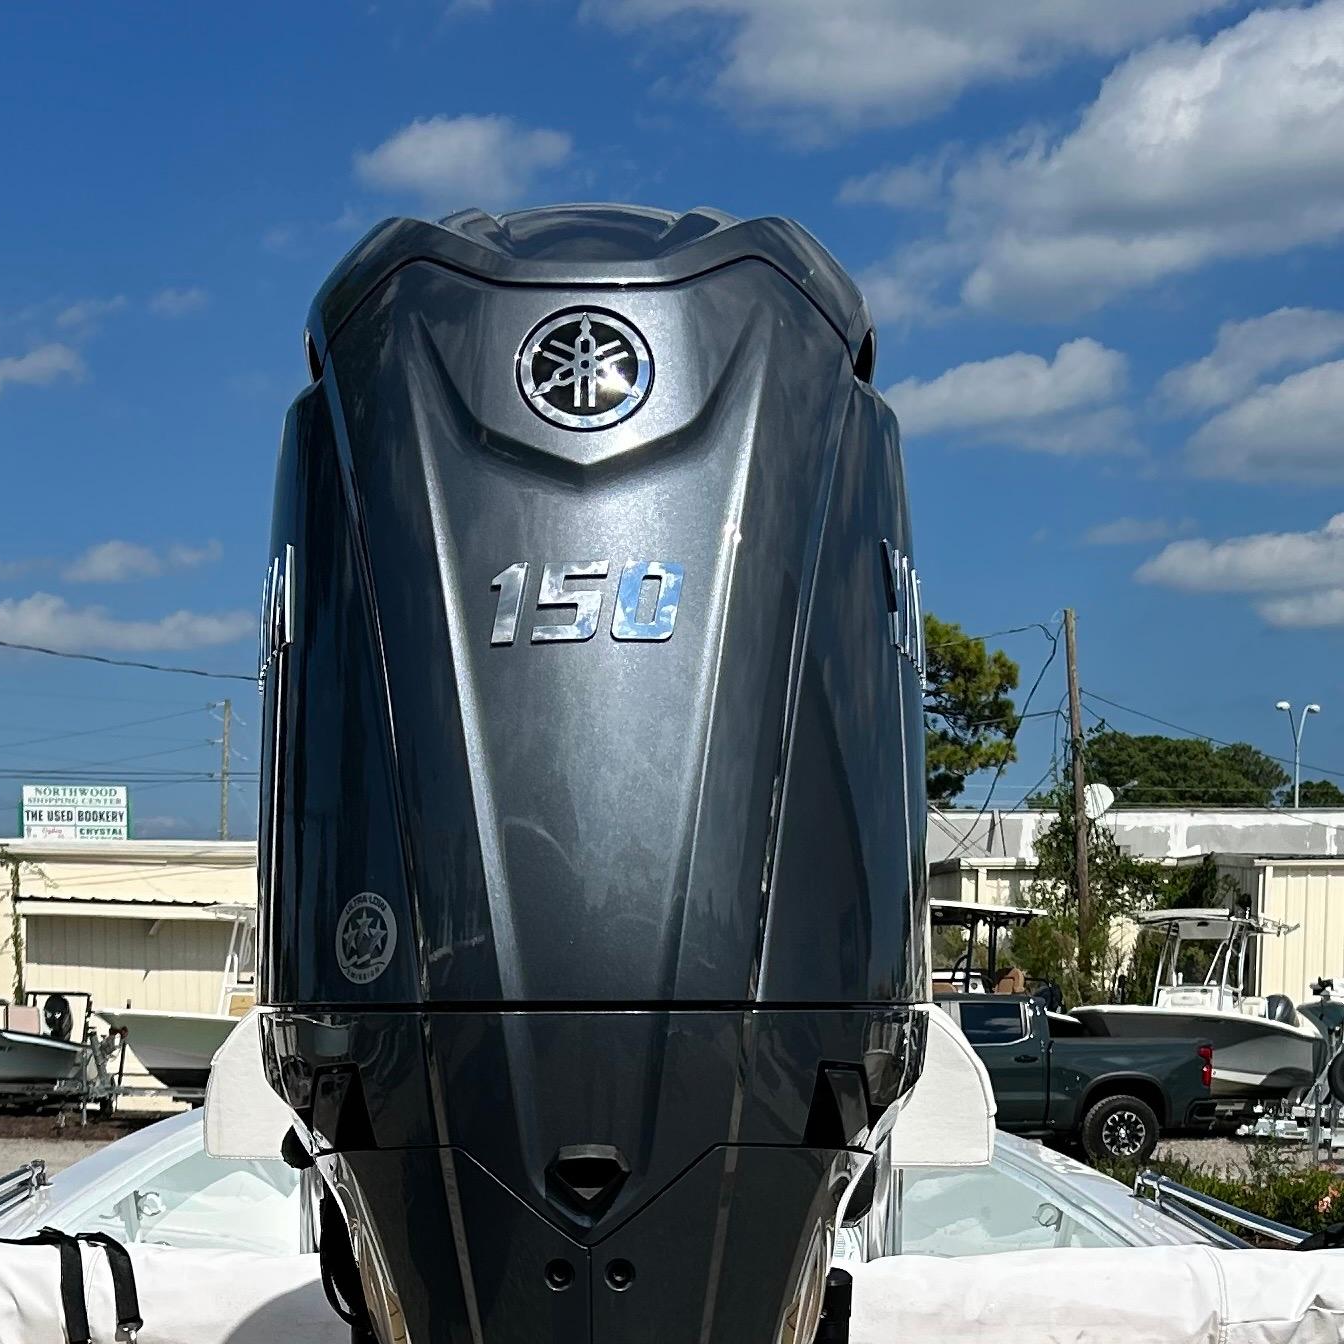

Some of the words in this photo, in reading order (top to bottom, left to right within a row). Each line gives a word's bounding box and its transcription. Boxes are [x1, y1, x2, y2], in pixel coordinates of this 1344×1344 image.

[489, 560, 686, 648] 150
[34, 787, 118, 797] NORTHWOOD
[81, 797, 122, 805] CENTER
[25, 810, 44, 822] THE
[47, 810, 74, 822] USED
[77, 810, 125, 822] BOOKERY
